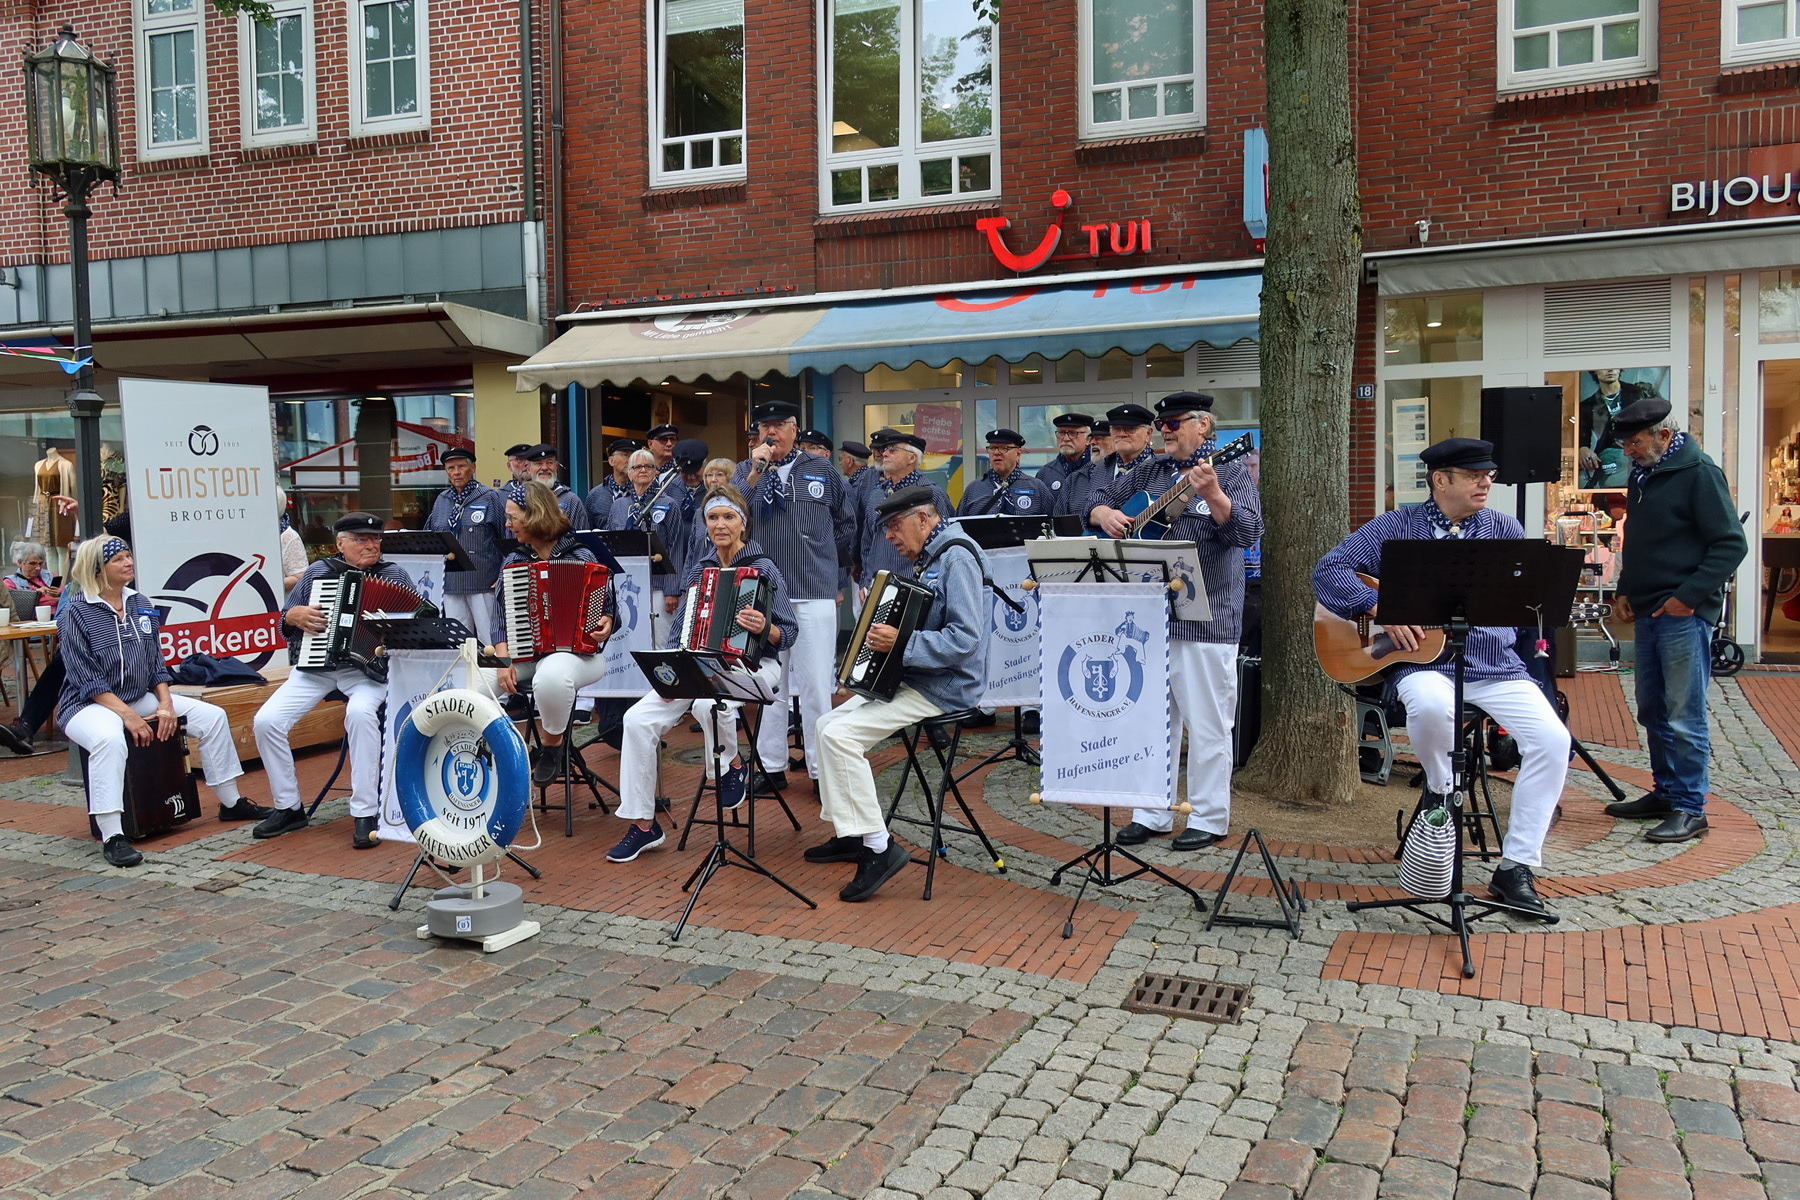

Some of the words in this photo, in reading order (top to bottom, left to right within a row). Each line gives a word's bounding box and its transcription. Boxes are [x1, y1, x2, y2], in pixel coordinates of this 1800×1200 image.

[1672, 173, 1791, 216] BIJOU
[1081, 220, 1150, 256] TUI
[1359, 386, 1372, 397] 18
[922, 415, 953, 427] Erlebe
[921, 426, 952, 436] echtes
[170, 508, 246, 522] BROTGUT
[159, 618, 276, 661] Bäckerei
[1076, 634, 1116, 649] STADER
[1004, 654, 1032, 670] Stader
[425, 698, 475, 719] STADER
[1069, 697, 1121, 719] HAFENSÄNGER
[452, 743, 477, 754] STADER
[1080, 736, 1118, 754] Stader
[1057, 755, 1130, 780] Hafensänger
[1133, 745, 1155, 762] e.V.
[441, 807, 460, 827] seit
[463, 811, 488, 830] 1977
[418, 829, 491, 861] HAFENSÄNGER
